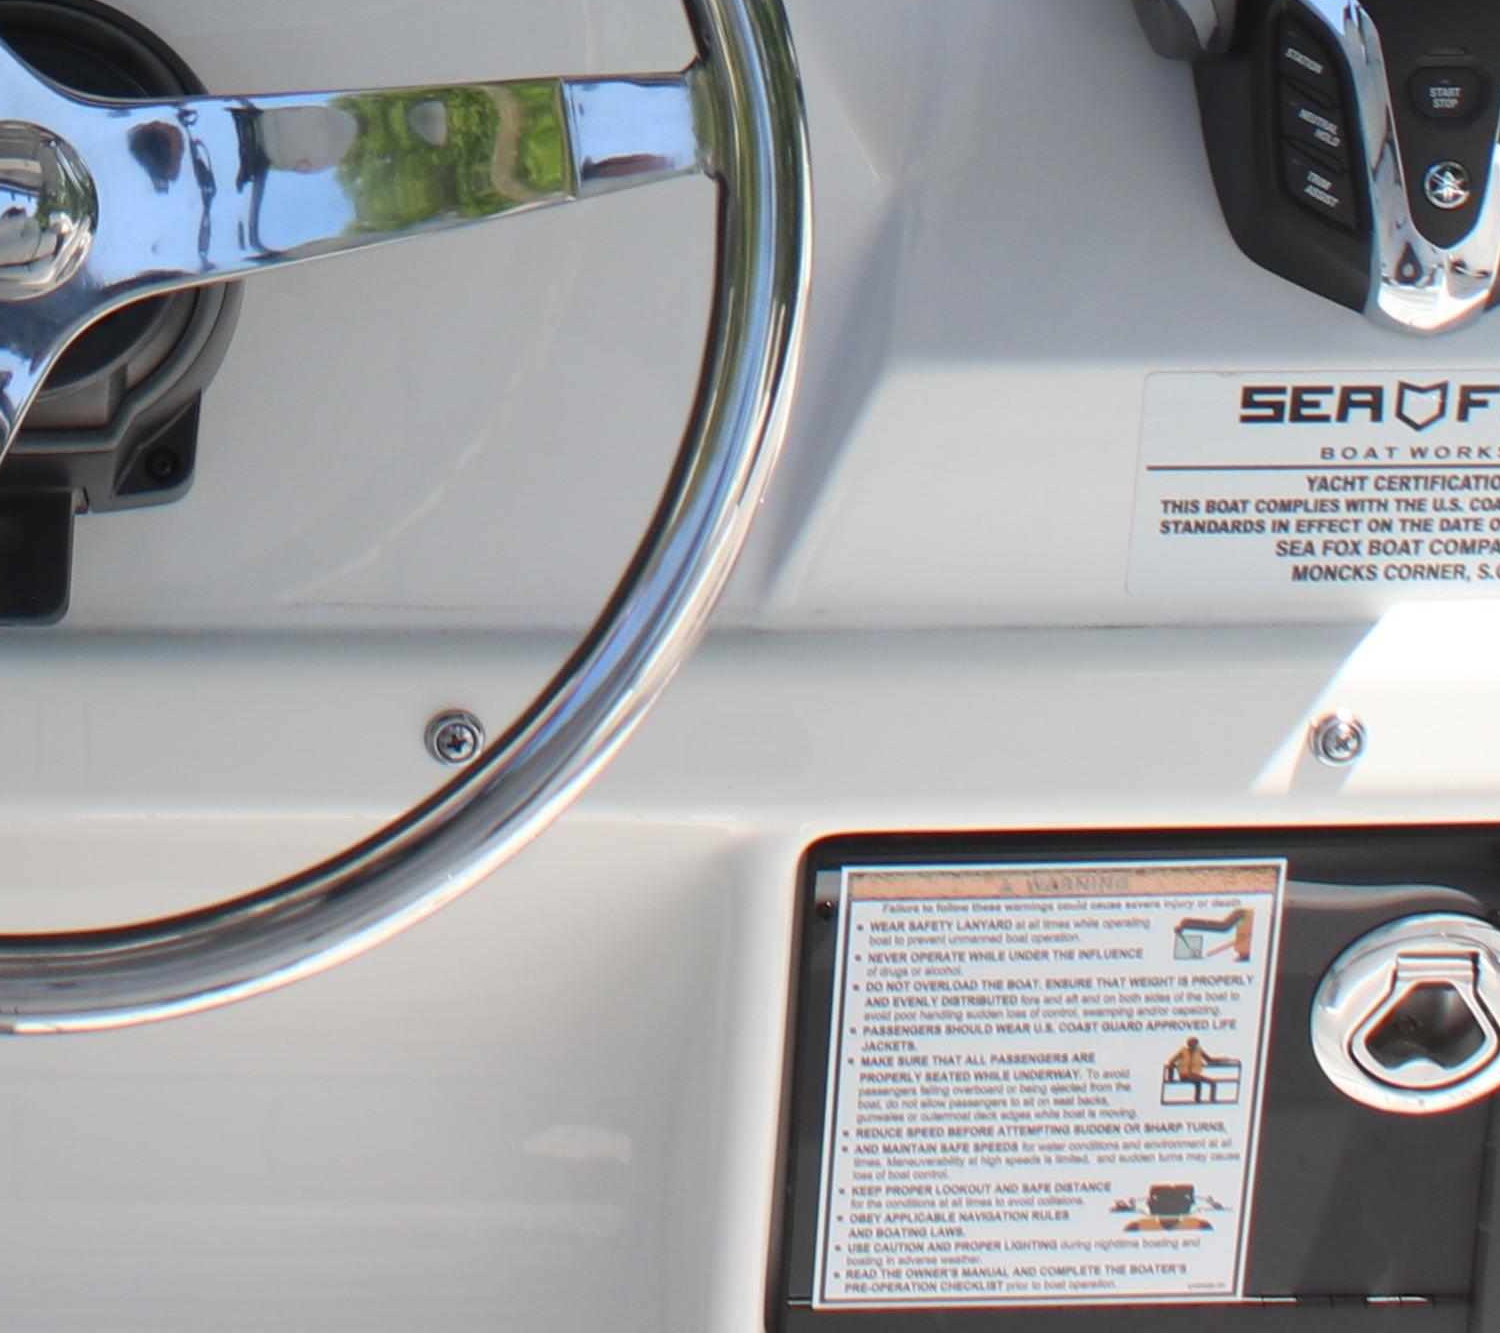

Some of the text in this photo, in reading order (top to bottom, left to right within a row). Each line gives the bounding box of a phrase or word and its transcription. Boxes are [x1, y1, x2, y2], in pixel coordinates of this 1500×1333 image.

[1430, 87, 1461, 97] START
[1433, 98, 1458, 109] STOP
[1239, 385, 1384, 424] SEA
[1320, 446, 1399, 460] BOAT
[1306, 475, 1368, 492] YACHT
[1160, 499, 1200, 514] THIS
[1205, 499, 1250, 514] BOAT
[1255, 498, 1340, 513] COMPLIES
[1345, 498, 1389, 512] WITH
[1395, 498, 1427, 512] THE
[1432, 497, 1463, 512] U.S.
[1160, 519, 1265, 534] STANDARDS
[1271, 519, 1290, 533] IN
[1295, 519, 1362, 533] EFFECT
[1367, 519, 1393, 533] ON
[1399, 518, 1434, 532] THE
[1439, 518, 1484, 532] DATE
[1275, 540, 1315, 556] SEA
[1322, 540, 1362, 556] FOX
[1367, 539, 1423, 556] BOAT
[1291, 564, 1378, 581] MONCKS
[1384, 564, 1471, 582] CORNER,
[1026, 876, 1131, 894] WARNING
[867, 948, 1144, 964] NEVER OPERATE WHILE UNDER THE INFLUENCE
